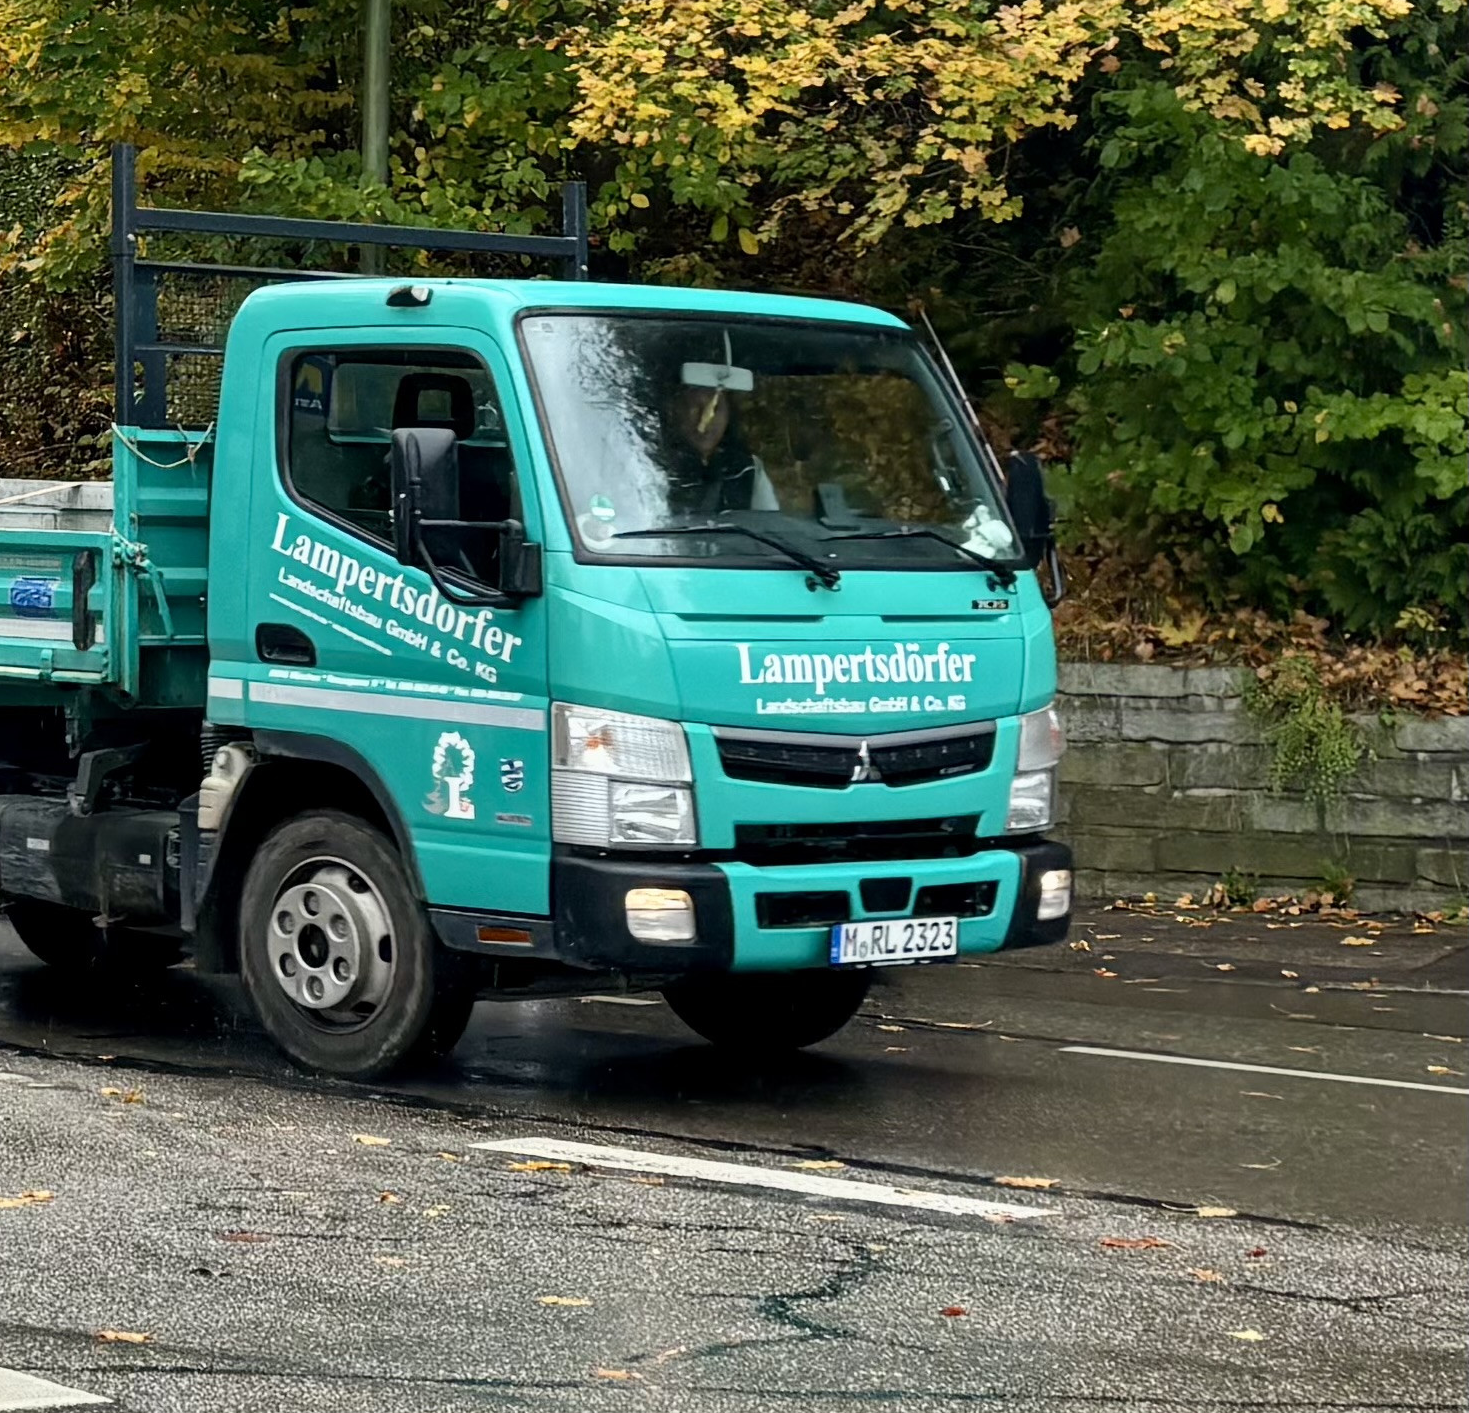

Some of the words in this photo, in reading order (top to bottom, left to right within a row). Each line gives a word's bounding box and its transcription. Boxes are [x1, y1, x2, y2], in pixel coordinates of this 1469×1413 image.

[278, 566, 383, 629] Landschaftsbau
[385, 619, 429, 651] GmbH
[430, 640, 442, 659] &
[446, 648, 471, 672] Co.
[475, 661, 498, 683] KG
[737, 642, 976, 695] Lampertsdörfer
[757, 698, 866, 714] Landschaftsbau
[869, 696, 908, 713] GmbH
[910, 695, 921, 712] &
[924, 694, 946, 712] Co.
[844, 927, 858, 957] M
[871, 925, 898, 955] RL
[903, 920, 954, 953] 2323
